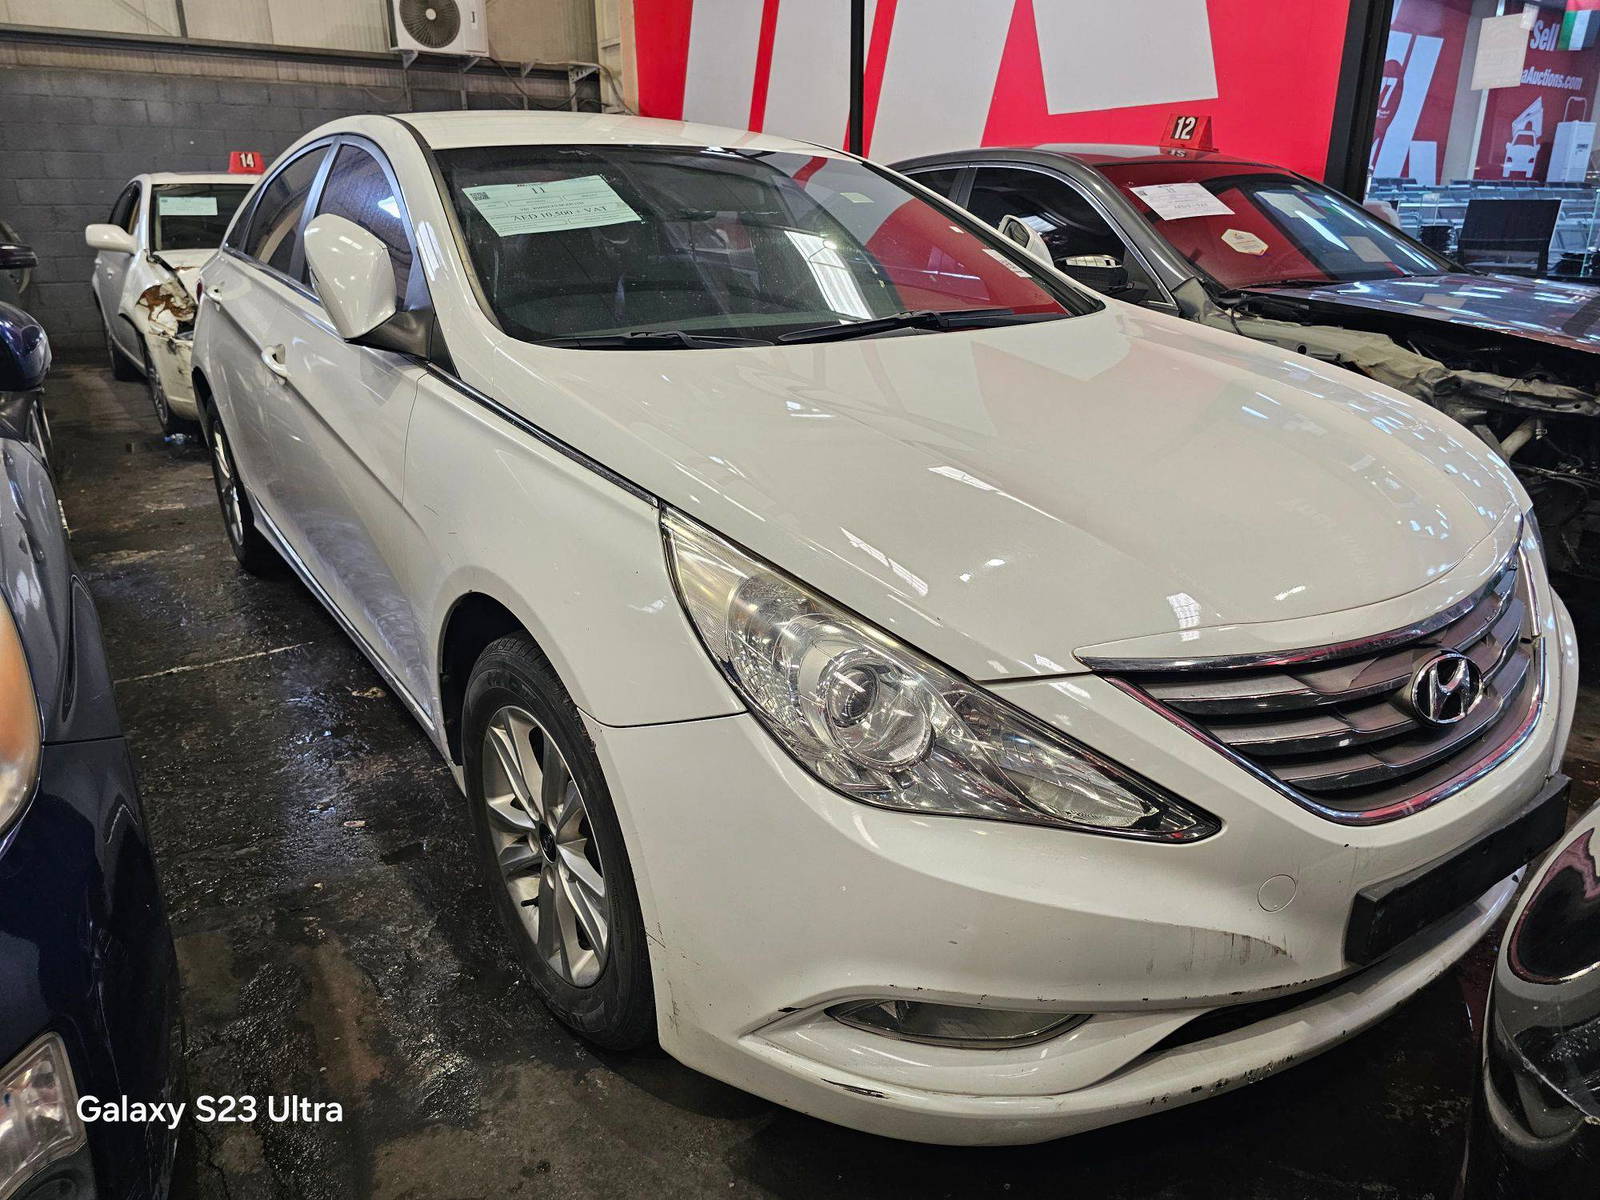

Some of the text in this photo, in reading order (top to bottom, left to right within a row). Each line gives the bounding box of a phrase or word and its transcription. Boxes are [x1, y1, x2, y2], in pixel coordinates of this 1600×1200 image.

[1530, 20, 1560, 51] Sell
[1174, 116, 1197, 140] 12
[240, 152, 255, 168] 14
